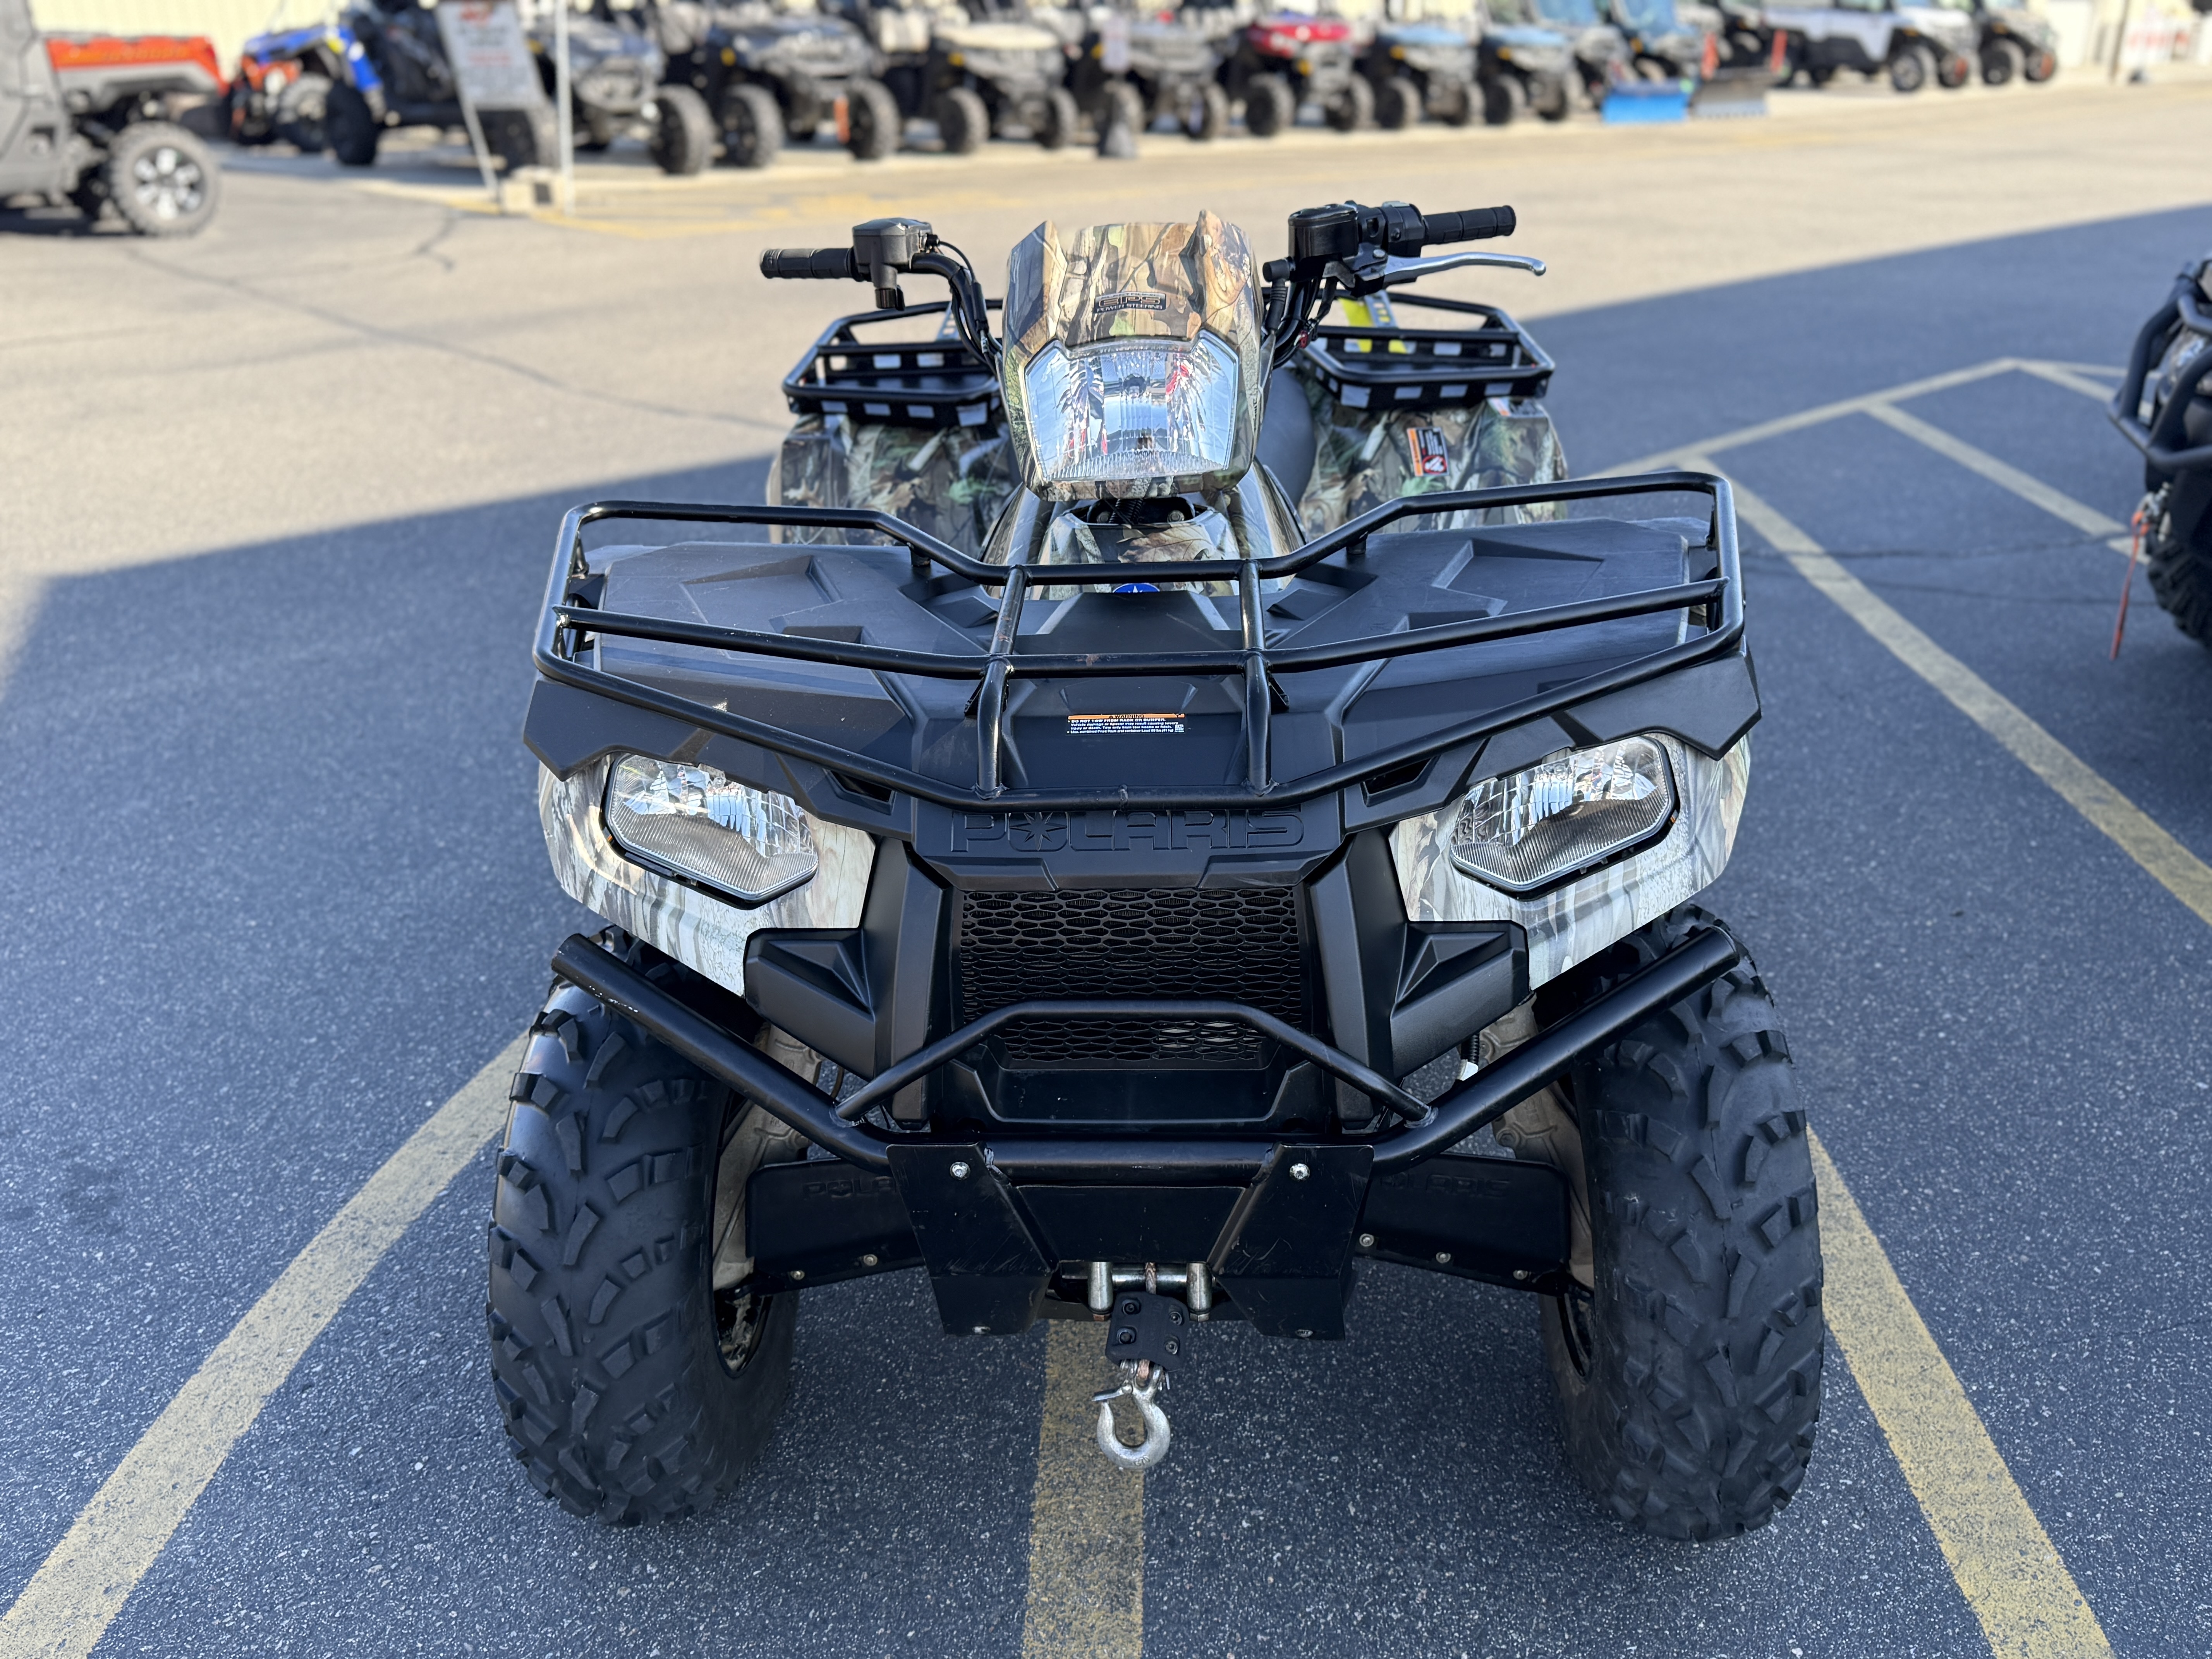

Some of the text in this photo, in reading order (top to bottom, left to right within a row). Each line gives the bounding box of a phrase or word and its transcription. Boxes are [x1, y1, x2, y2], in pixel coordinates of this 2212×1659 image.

[1097, 304, 1124, 313] POWER
[1099, 296, 1161, 307] EPS
[951, 805, 1304, 852] POLARIS
[803, 1176, 897, 1200] POLA
[1379, 1171, 1510, 1199] OLARIS
